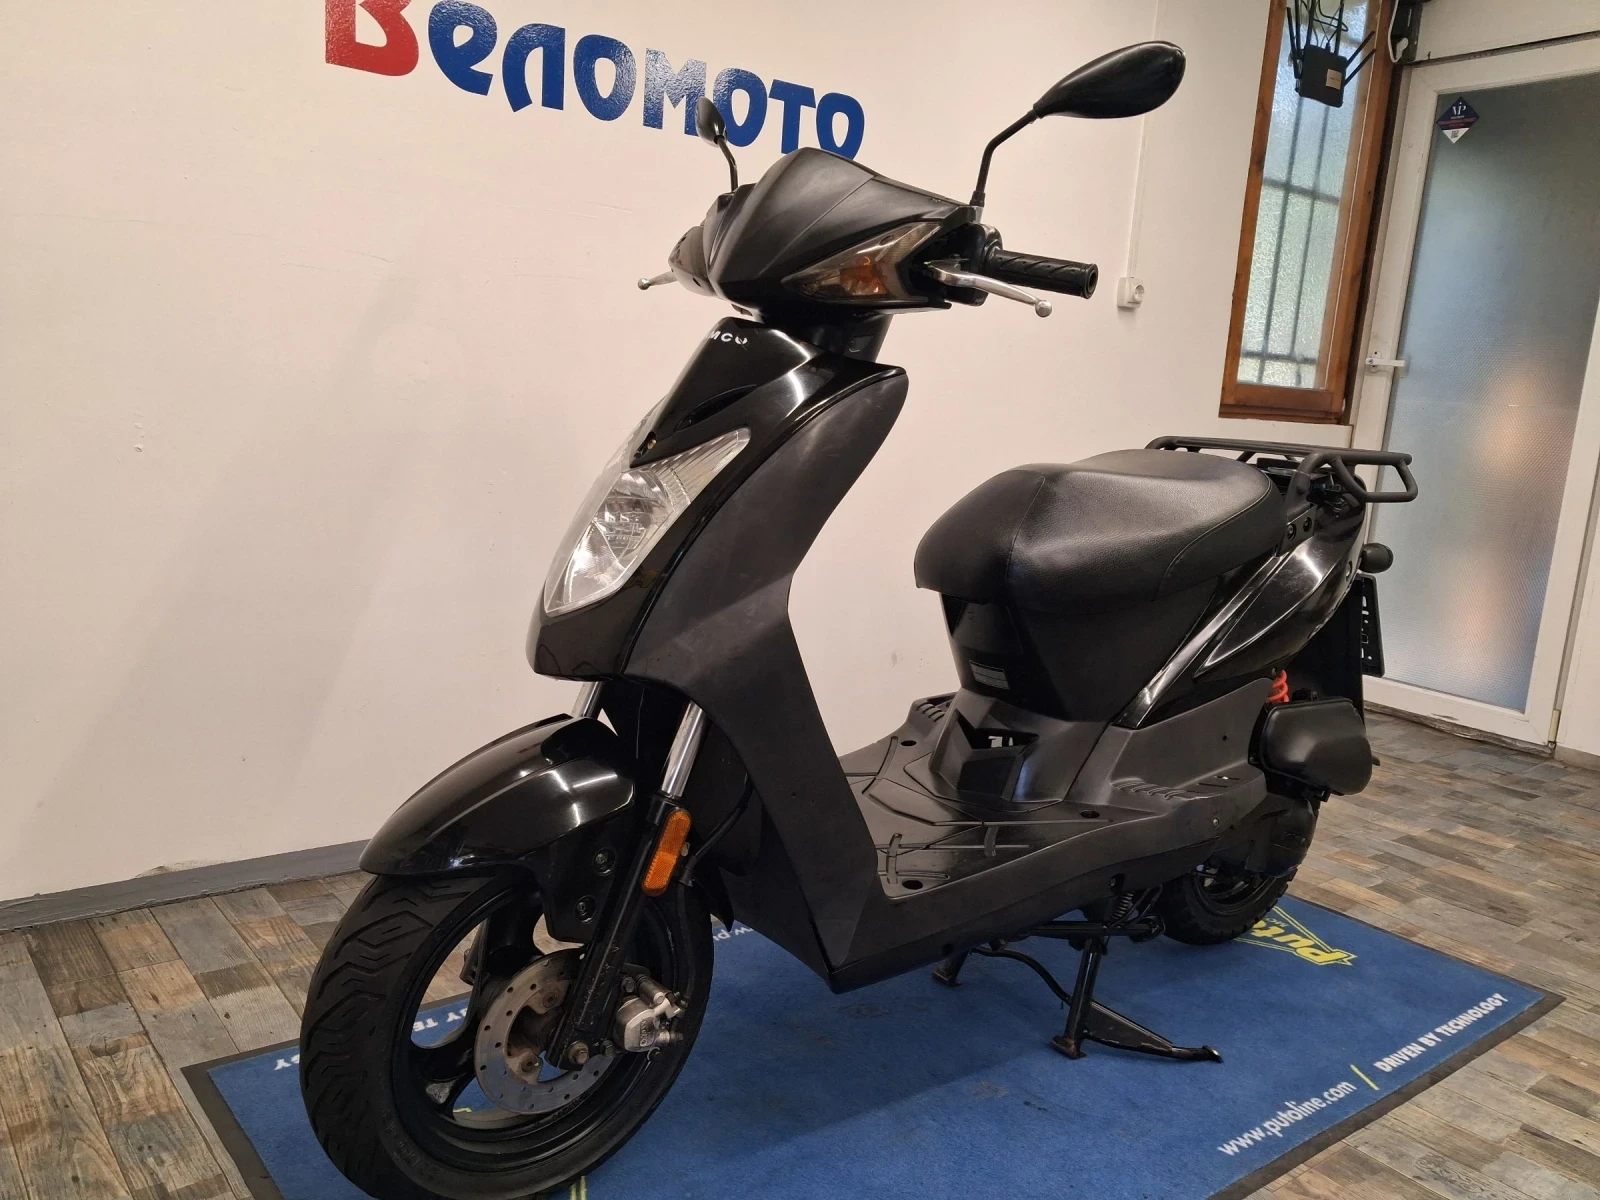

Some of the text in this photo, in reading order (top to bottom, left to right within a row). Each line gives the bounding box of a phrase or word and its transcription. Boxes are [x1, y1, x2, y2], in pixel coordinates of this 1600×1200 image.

[1218, 992, 1509, 1156] www.putoline.com DRIVEN BY TECHNOLOGY
